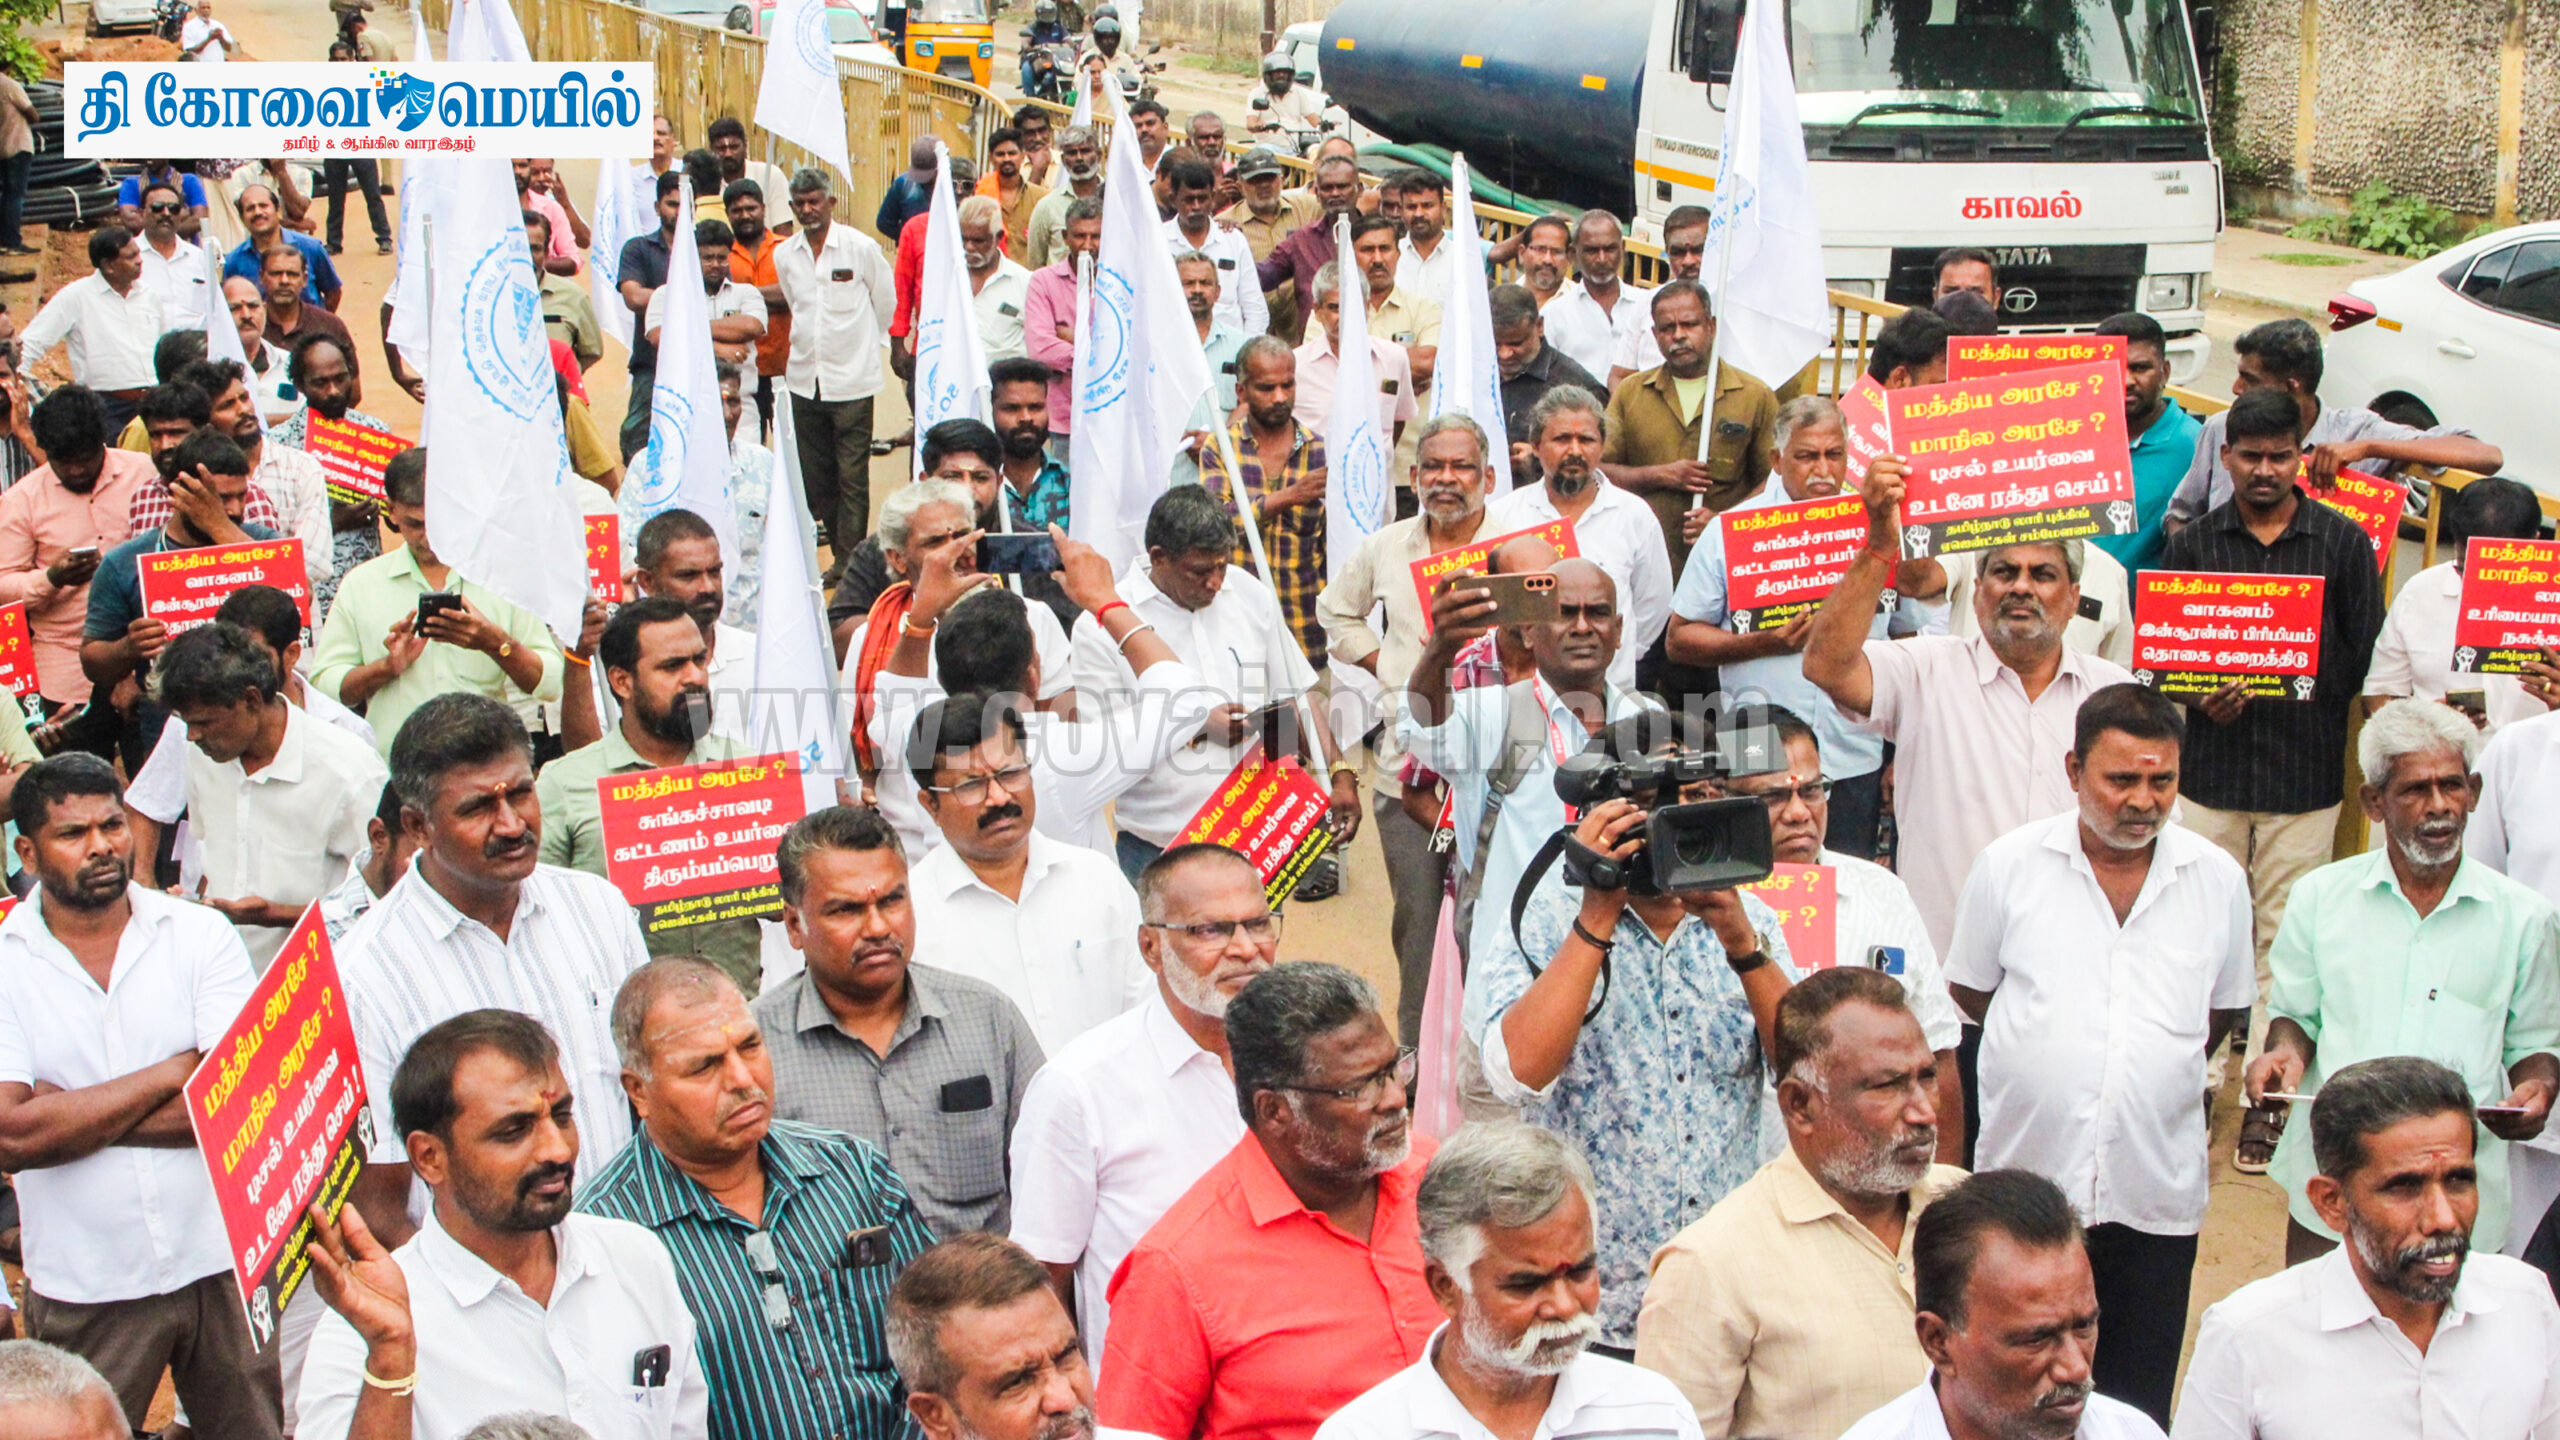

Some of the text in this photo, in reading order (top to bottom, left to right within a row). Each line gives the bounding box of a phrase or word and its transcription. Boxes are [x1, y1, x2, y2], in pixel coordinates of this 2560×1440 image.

[1962, 190, 2083, 219] காவல்
[1995, 246, 2052, 266] TATA
[1960, 343, 2029, 361] மத்திய
[2034, 344, 2096, 361] அரசே
[1903, 389, 1993, 420] மத்திய
[1999, 379, 2081, 405] அரசே
[1909, 429, 1995, 455] மாநில
[2001, 417, 2083, 443] அரசே
[1992, 448, 2095, 475] உயர்வை
[1908, 492, 1984, 517] உடனே
[1990, 482, 2049, 511] ரத்து
[2055, 471, 2109, 500] செய்
[1732, 501, 1863, 532] மத்திய அரசே
[1752, 526, 1866, 553] சுங்கச்சாவடி
[2479, 542, 2554, 563] மத்திய
[151, 553, 217, 573] மத்திய
[220, 547, 276, 564] அரசே
[1731, 544, 1860, 578] கட்டணம் உயர்
[185, 566, 265, 589] வாகனம்
[2148, 577, 2222, 596] மத்திய
[2226, 582, 2293, 598] அரசே
[2478, 566, 2549, 585] மாநில
[2182, 601, 2274, 620] வாகனம்
[2137, 621, 2240, 642] இன்சூரன்ஸ்
[2141, 646, 2310, 669] தொகை குறைத்திடு
[612, 775, 693, 802] மத்திய
[698, 764, 768, 789] அரசே
[638, 797, 773, 831] சுங்கச்சாவடி
[613, 830, 709, 863] கட்டணம்
[642, 853, 778, 890] திரும்பப்பெறு
[203, 1024, 264, 1120] மத்திய
[263, 952, 308, 1032] அரசே
[222, 1083, 278, 1176] மாநில
[278, 1008, 322, 1090] அரசே
[283, 1047, 340, 1148] உயர்வை
[244, 1187, 293, 1278] உடனே
[292, 1132, 328, 1205] ரத்து
[325, 1076, 355, 1142] செய்
